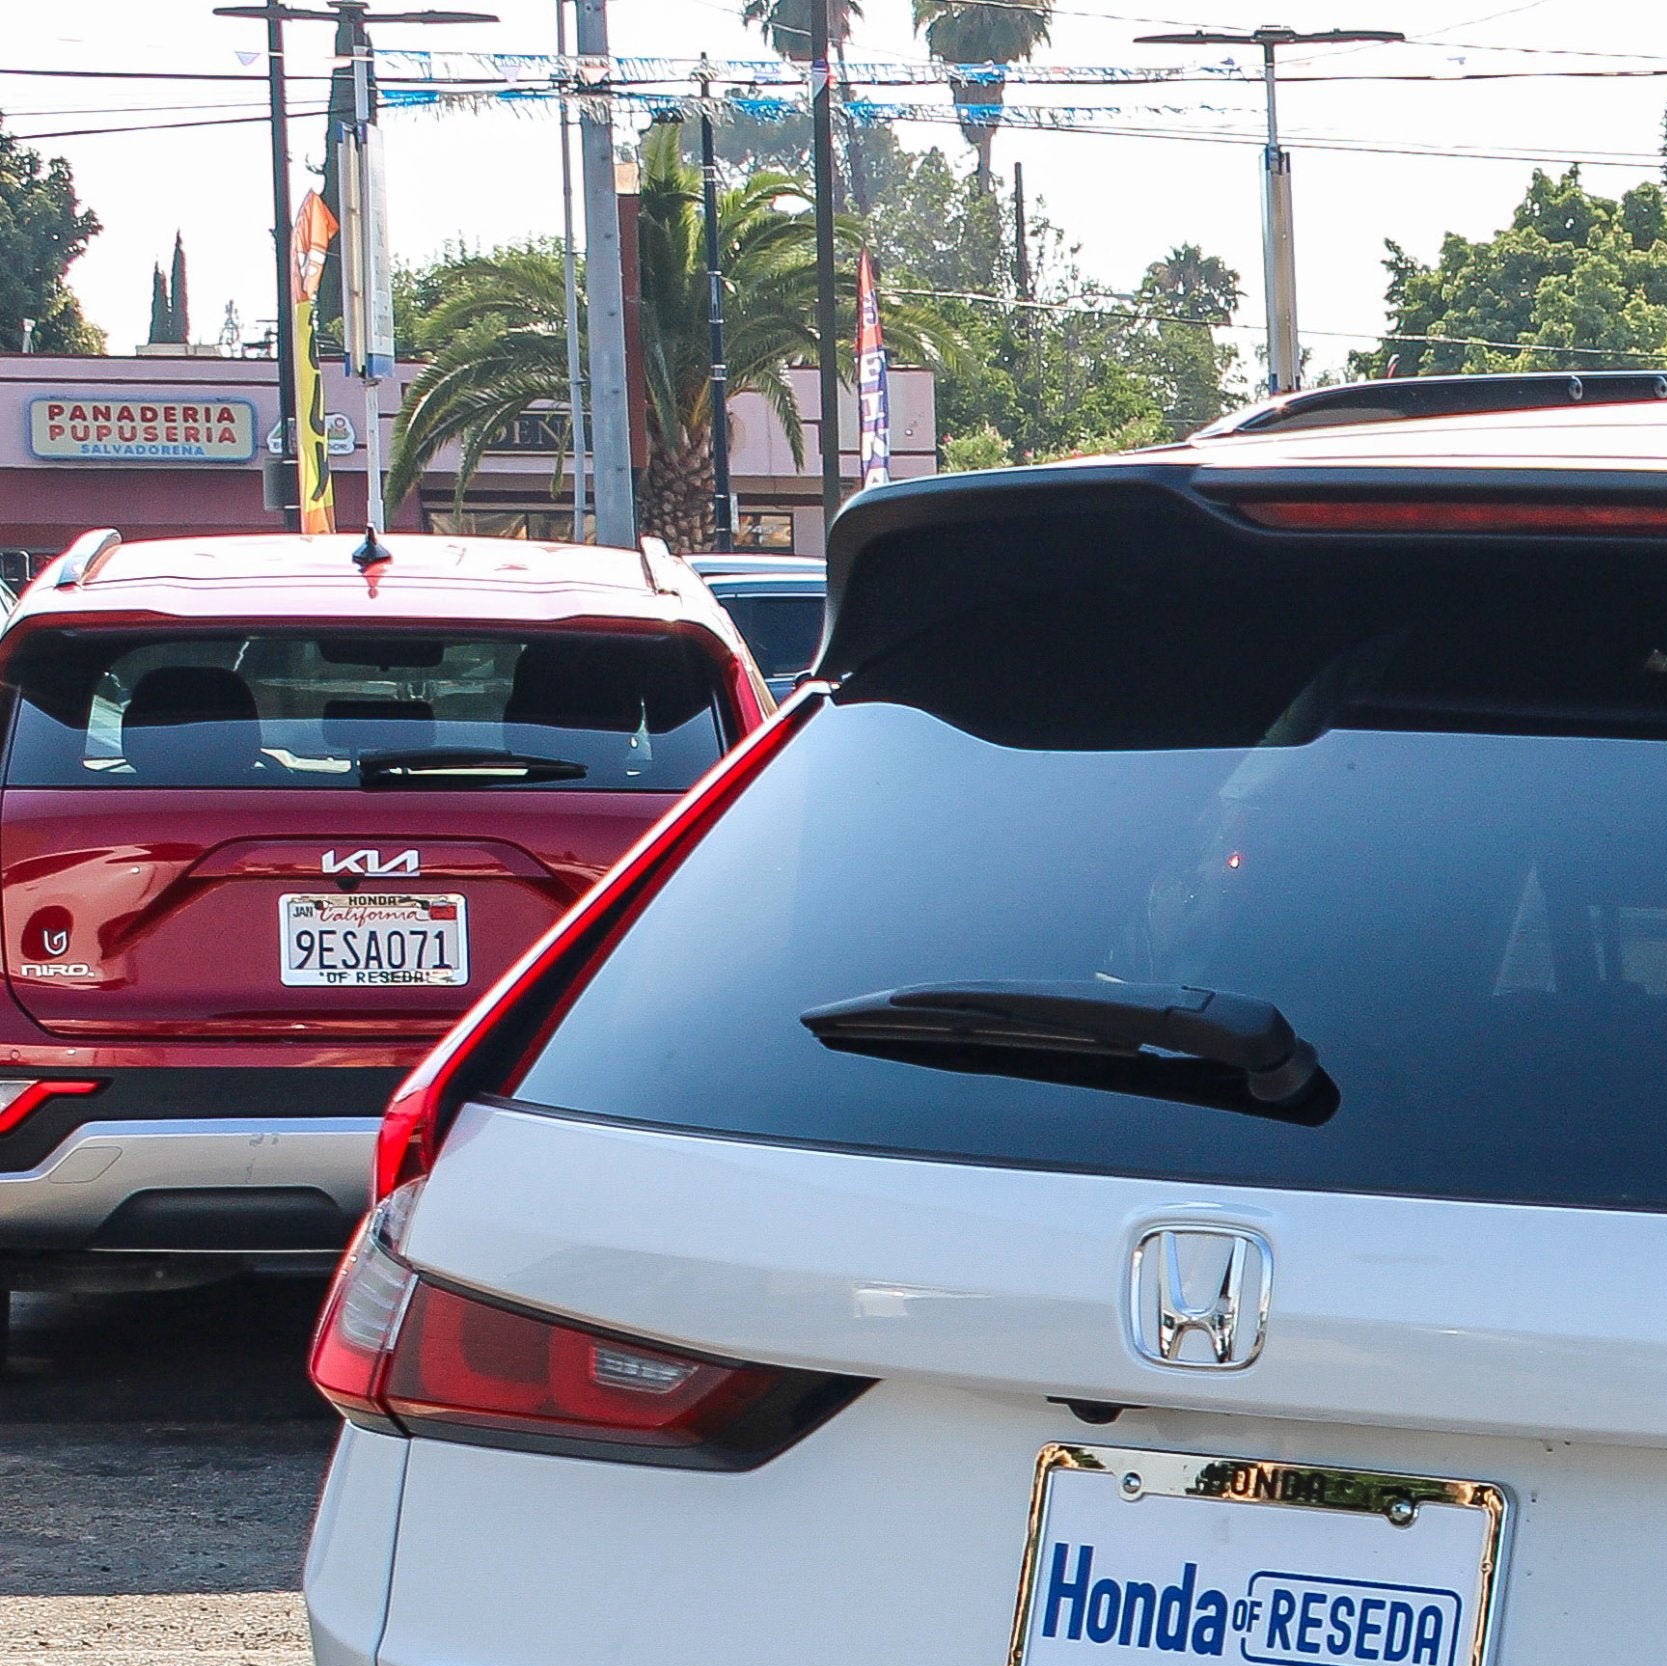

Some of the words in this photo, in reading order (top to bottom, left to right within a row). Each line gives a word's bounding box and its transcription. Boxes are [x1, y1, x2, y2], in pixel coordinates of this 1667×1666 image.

[47, 404, 236, 424] PANADERIA
[47, 424, 238, 444] PUPUSERIA
[321, 848, 420, 875] KIA
[349, 896, 397, 906] HONDA
[292, 905, 314, 918] JAN
[319, 906, 431, 928] California
[296, 929, 453, 969] 9ESA071
[327, 971, 350, 984] OF
[1041, 1542, 1231, 1657] Honda
[1233, 1598, 1262, 1633] OF
[1266, 1588, 1444, 1666] RESEDA
